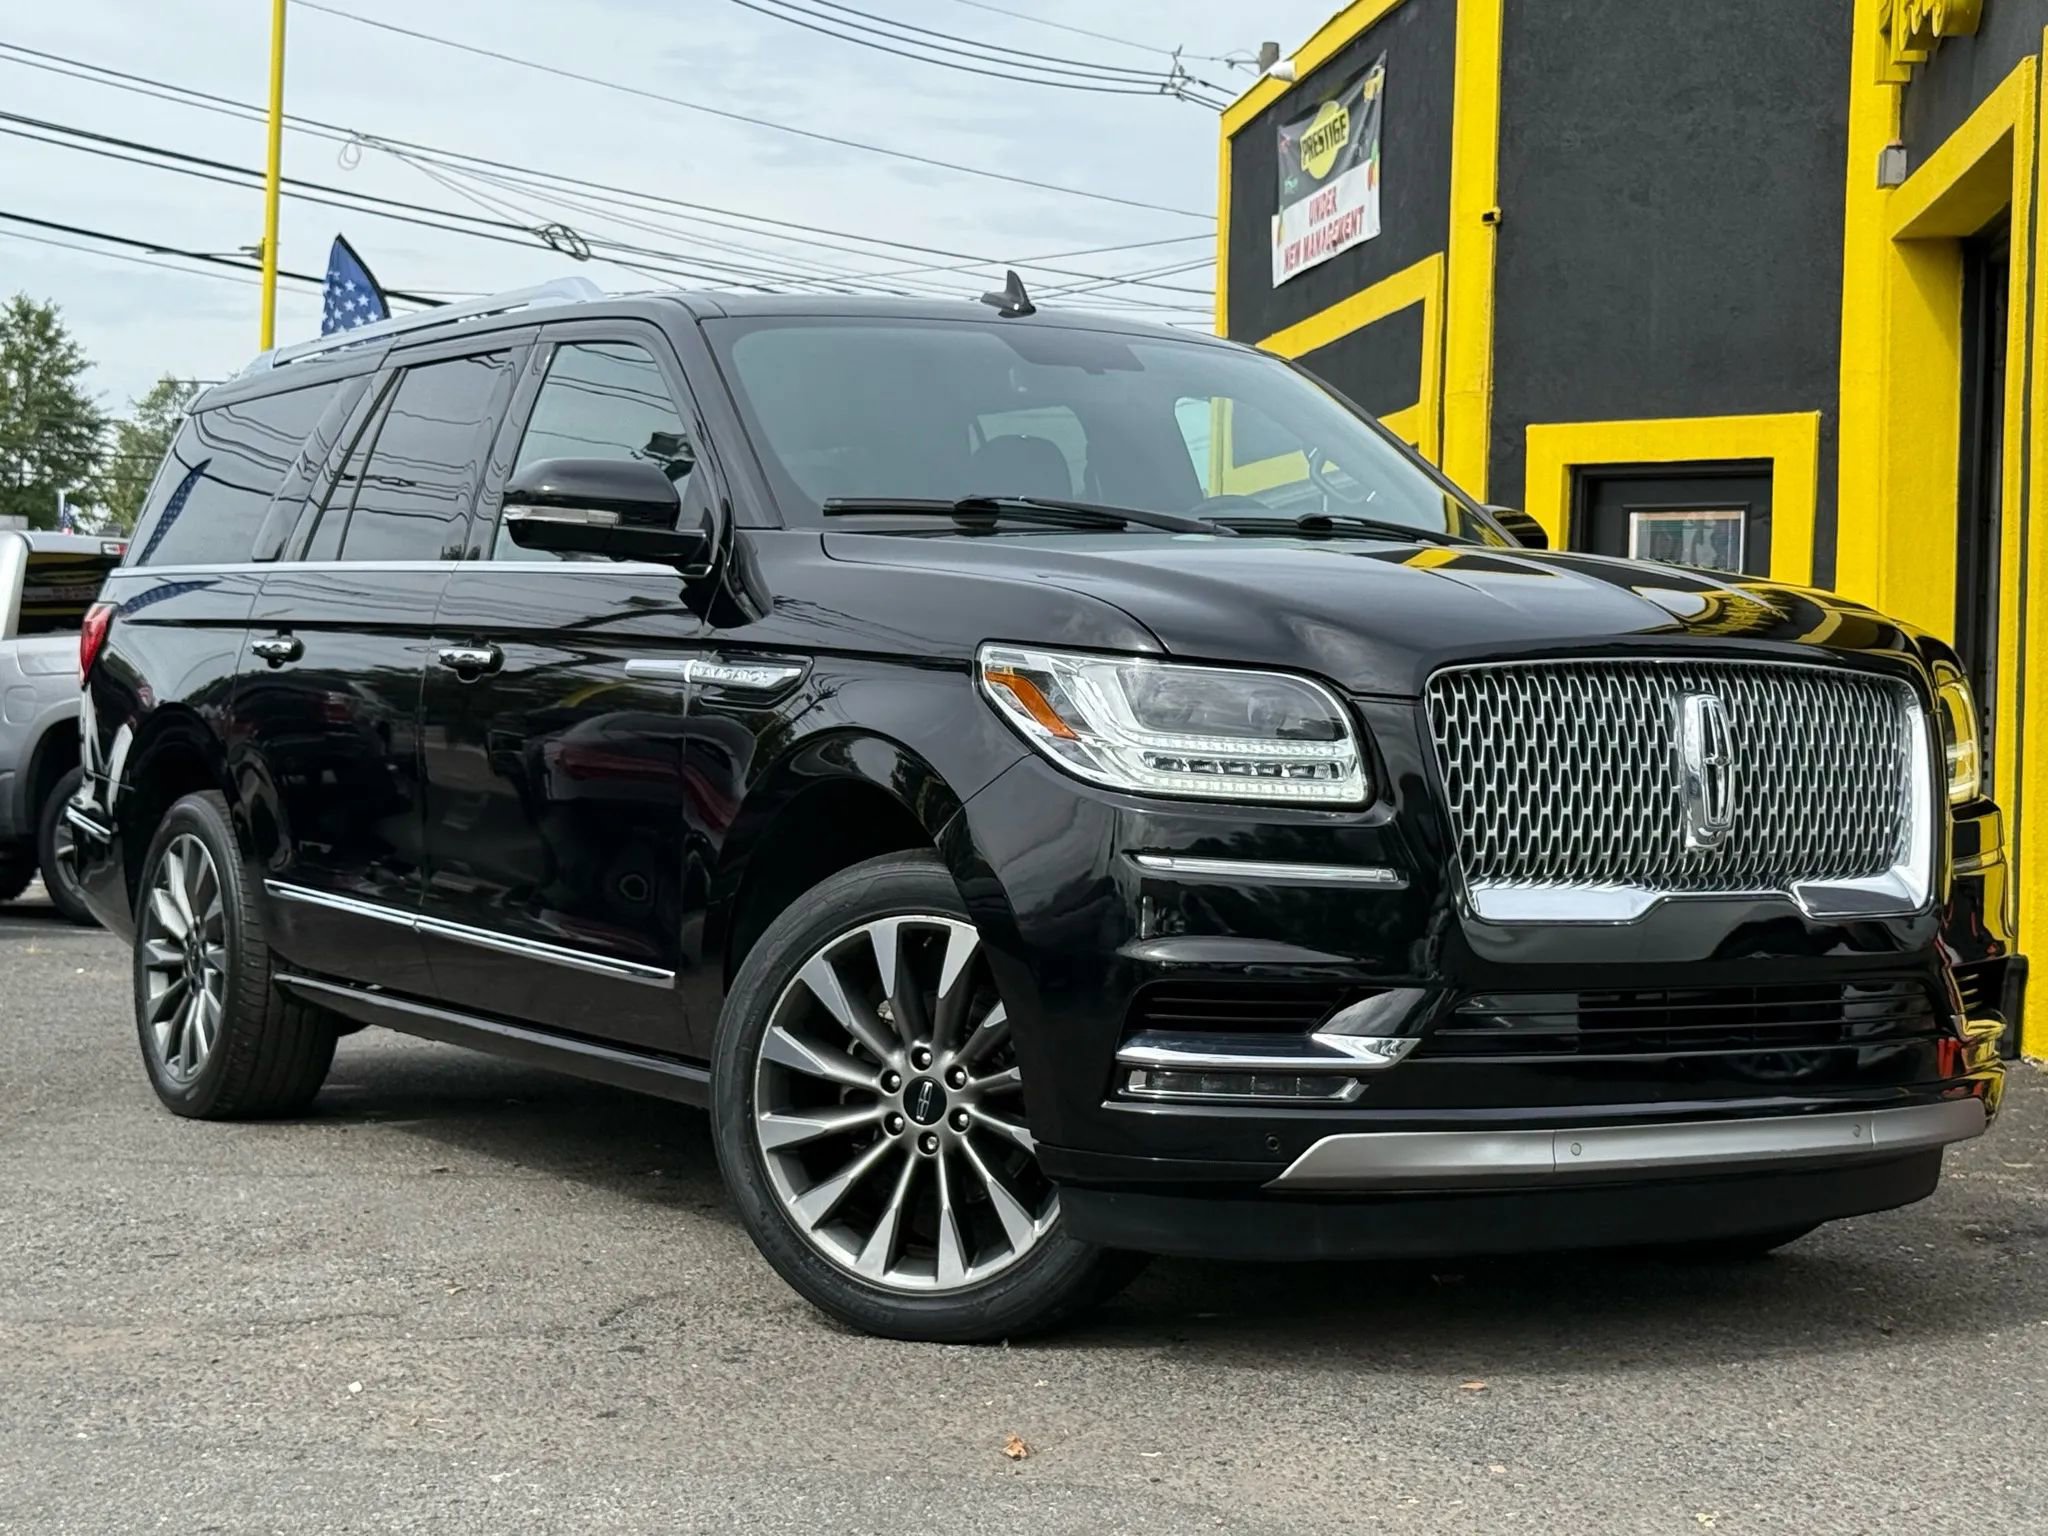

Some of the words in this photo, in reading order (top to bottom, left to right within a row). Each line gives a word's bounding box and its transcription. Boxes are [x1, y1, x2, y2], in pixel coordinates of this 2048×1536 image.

[1302, 112, 1347, 164] PRESTIGE
[1309, 186, 1337, 227] UNDER
[1284, 239, 1302, 274] NEW
[1303, 205, 1365, 264] MANAGEMENT
[692, 666, 769, 683] NAVIGATOR
